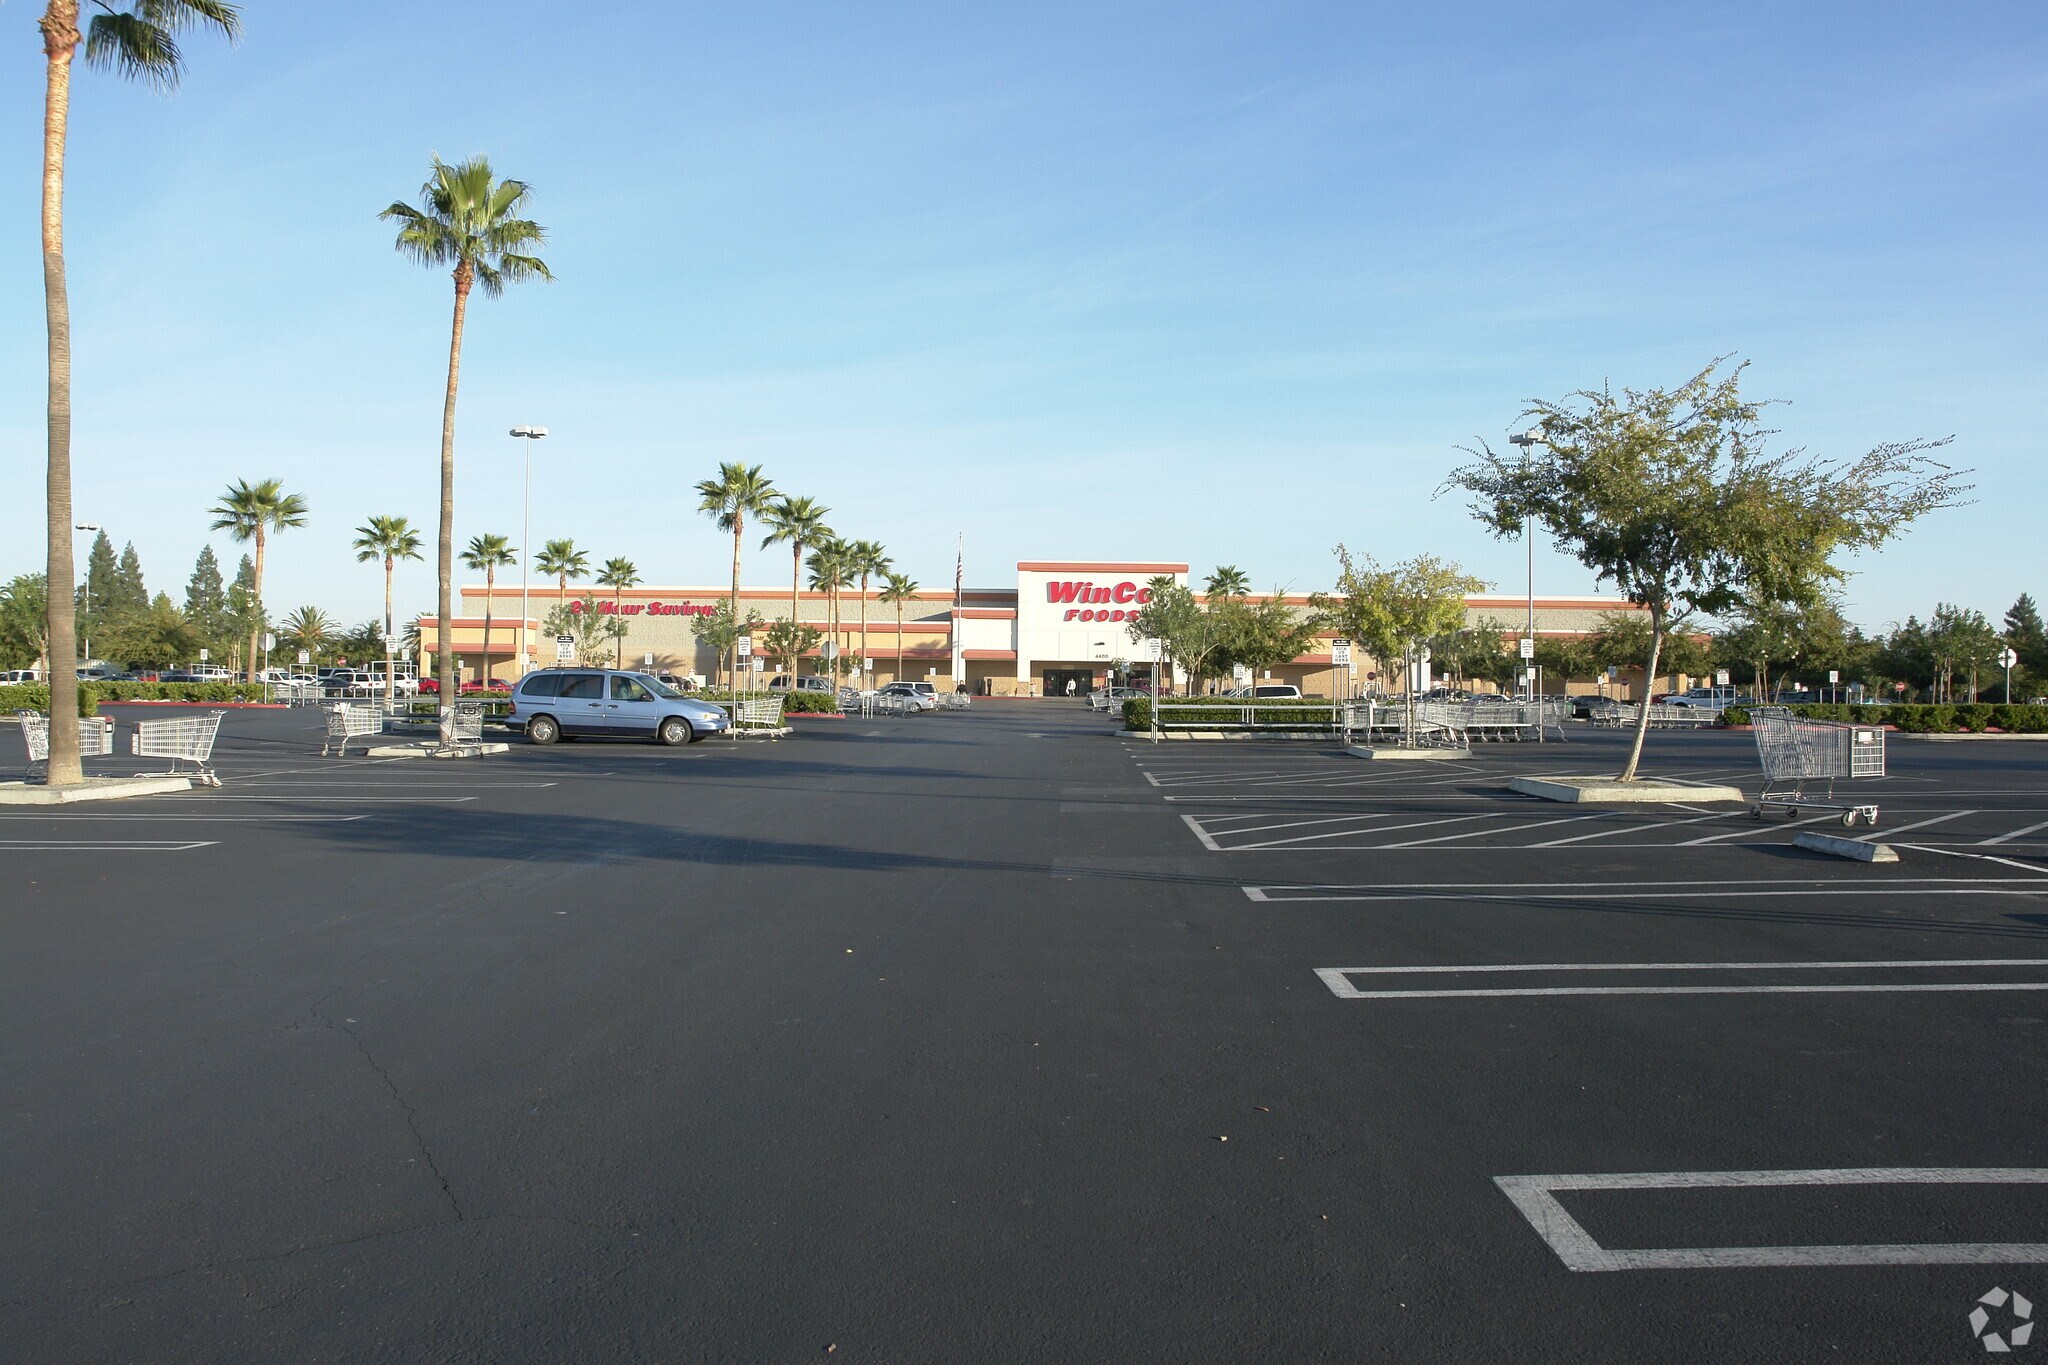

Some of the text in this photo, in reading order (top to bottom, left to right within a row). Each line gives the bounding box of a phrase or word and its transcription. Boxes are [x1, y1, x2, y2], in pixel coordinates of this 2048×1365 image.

[1046, 581, 1154, 604] WinCo
[646, 600, 719, 616] Saving
[1063, 609, 1141, 622] FOODS
